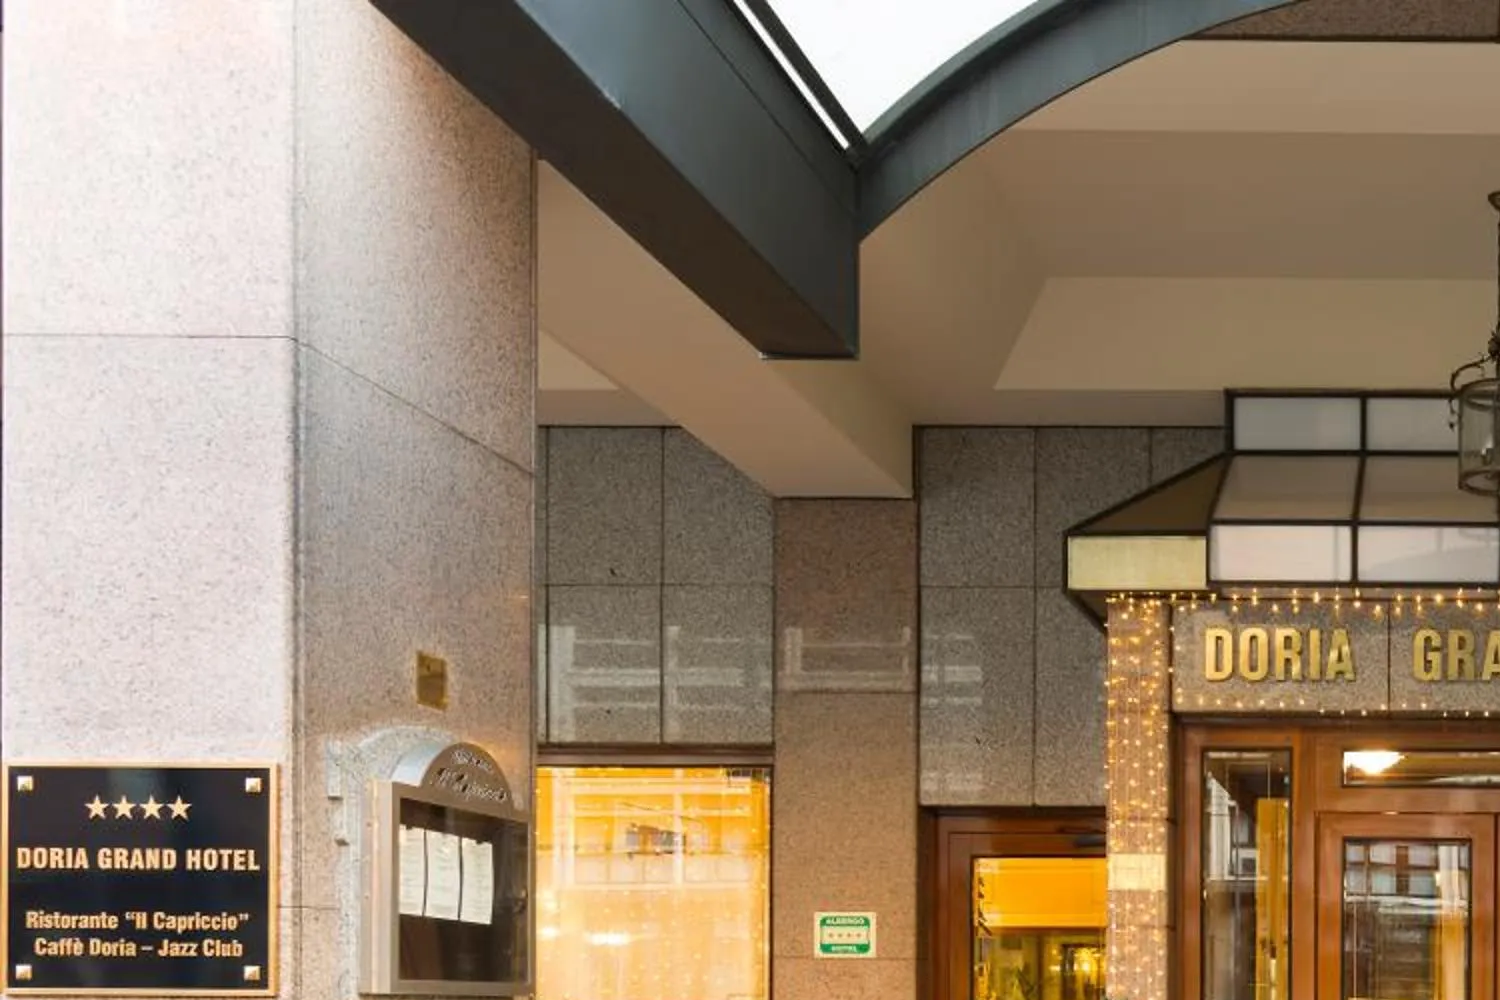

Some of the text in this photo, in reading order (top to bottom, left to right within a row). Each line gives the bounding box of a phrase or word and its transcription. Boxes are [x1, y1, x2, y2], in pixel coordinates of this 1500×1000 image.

[1204, 627, 1357, 683] DORIA
[16, 847, 261, 871] DORIA GRAND HOTEL
[25, 910, 119, 929] Ristorante
[34, 936, 84, 957] Caffè
[89, 937, 137, 957] Doria
[157, 938, 199, 957] Jazz
[202, 938, 244, 957] Club
